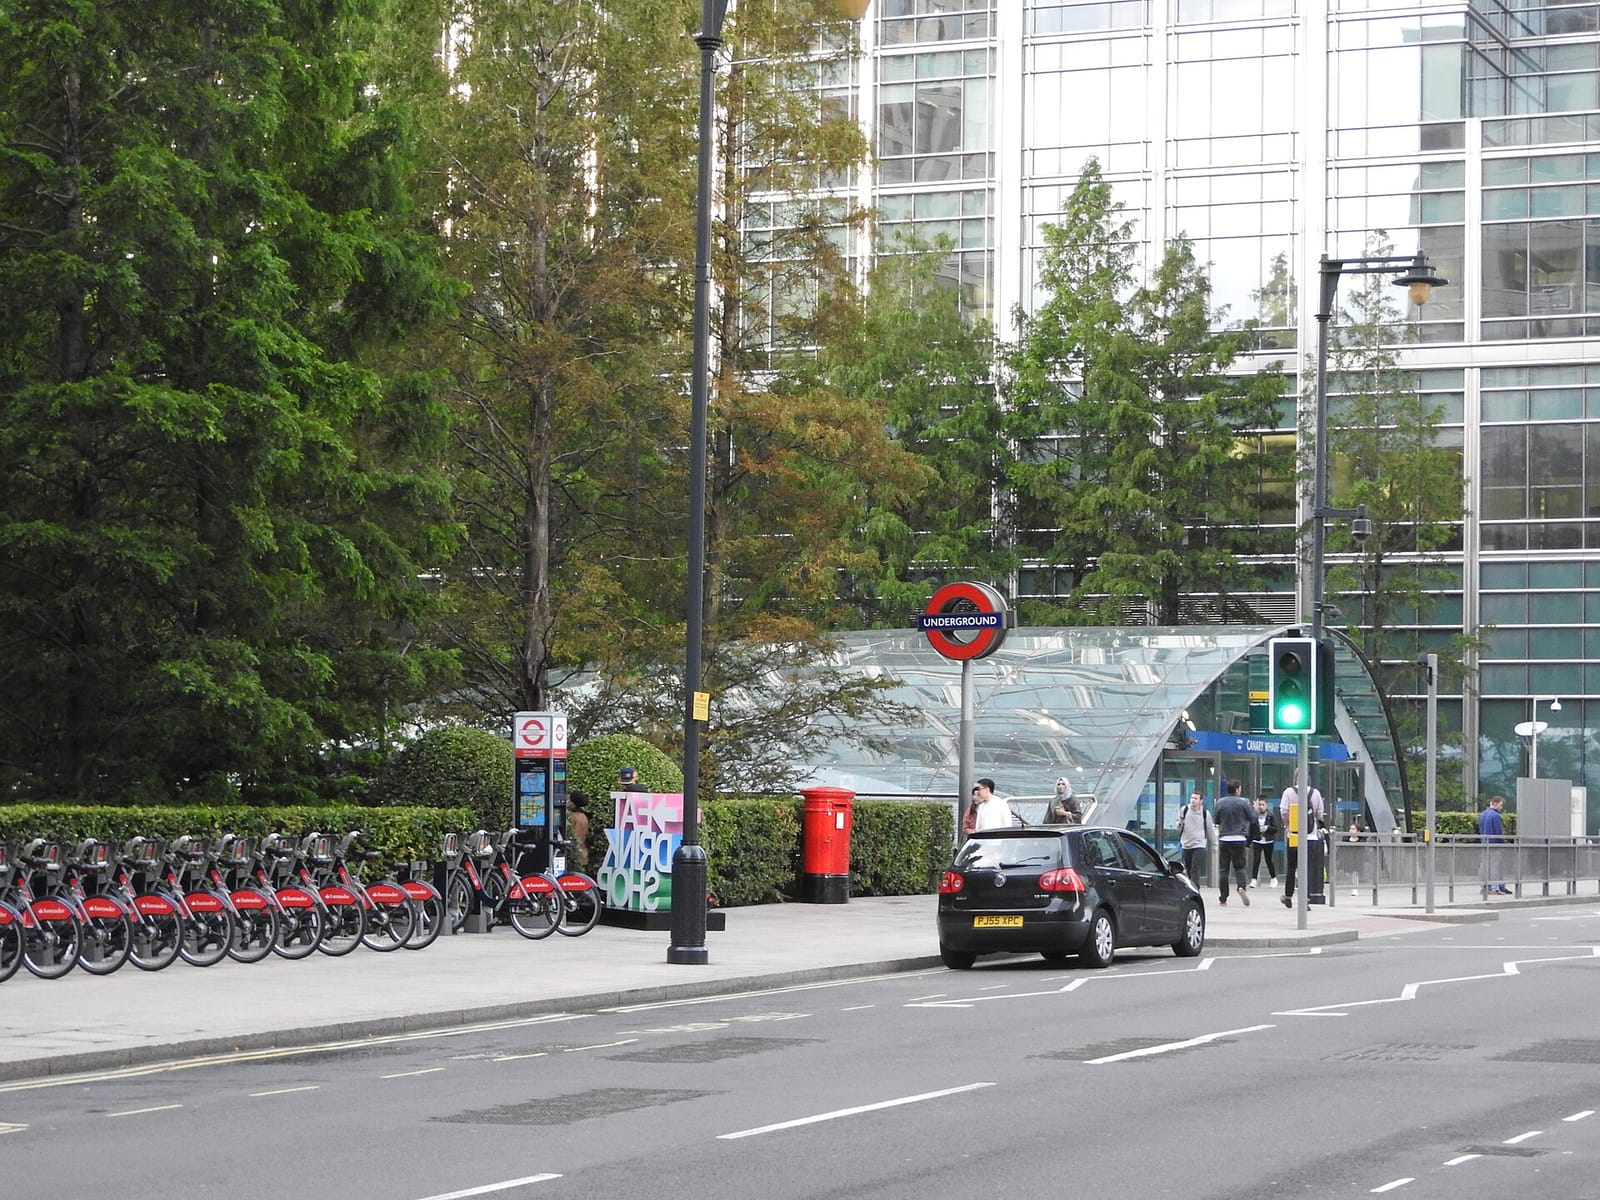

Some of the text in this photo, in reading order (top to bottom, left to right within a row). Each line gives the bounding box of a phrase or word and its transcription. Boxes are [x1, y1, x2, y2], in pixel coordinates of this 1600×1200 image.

[923, 616, 997, 627] UNDERGROUND
[1247, 740, 1264, 751] CANARY
[1265, 742, 1280, 753] WHARF
[1280, 743, 1297, 754] STATION
[978, 916, 1019, 925] PJ55 XPC
